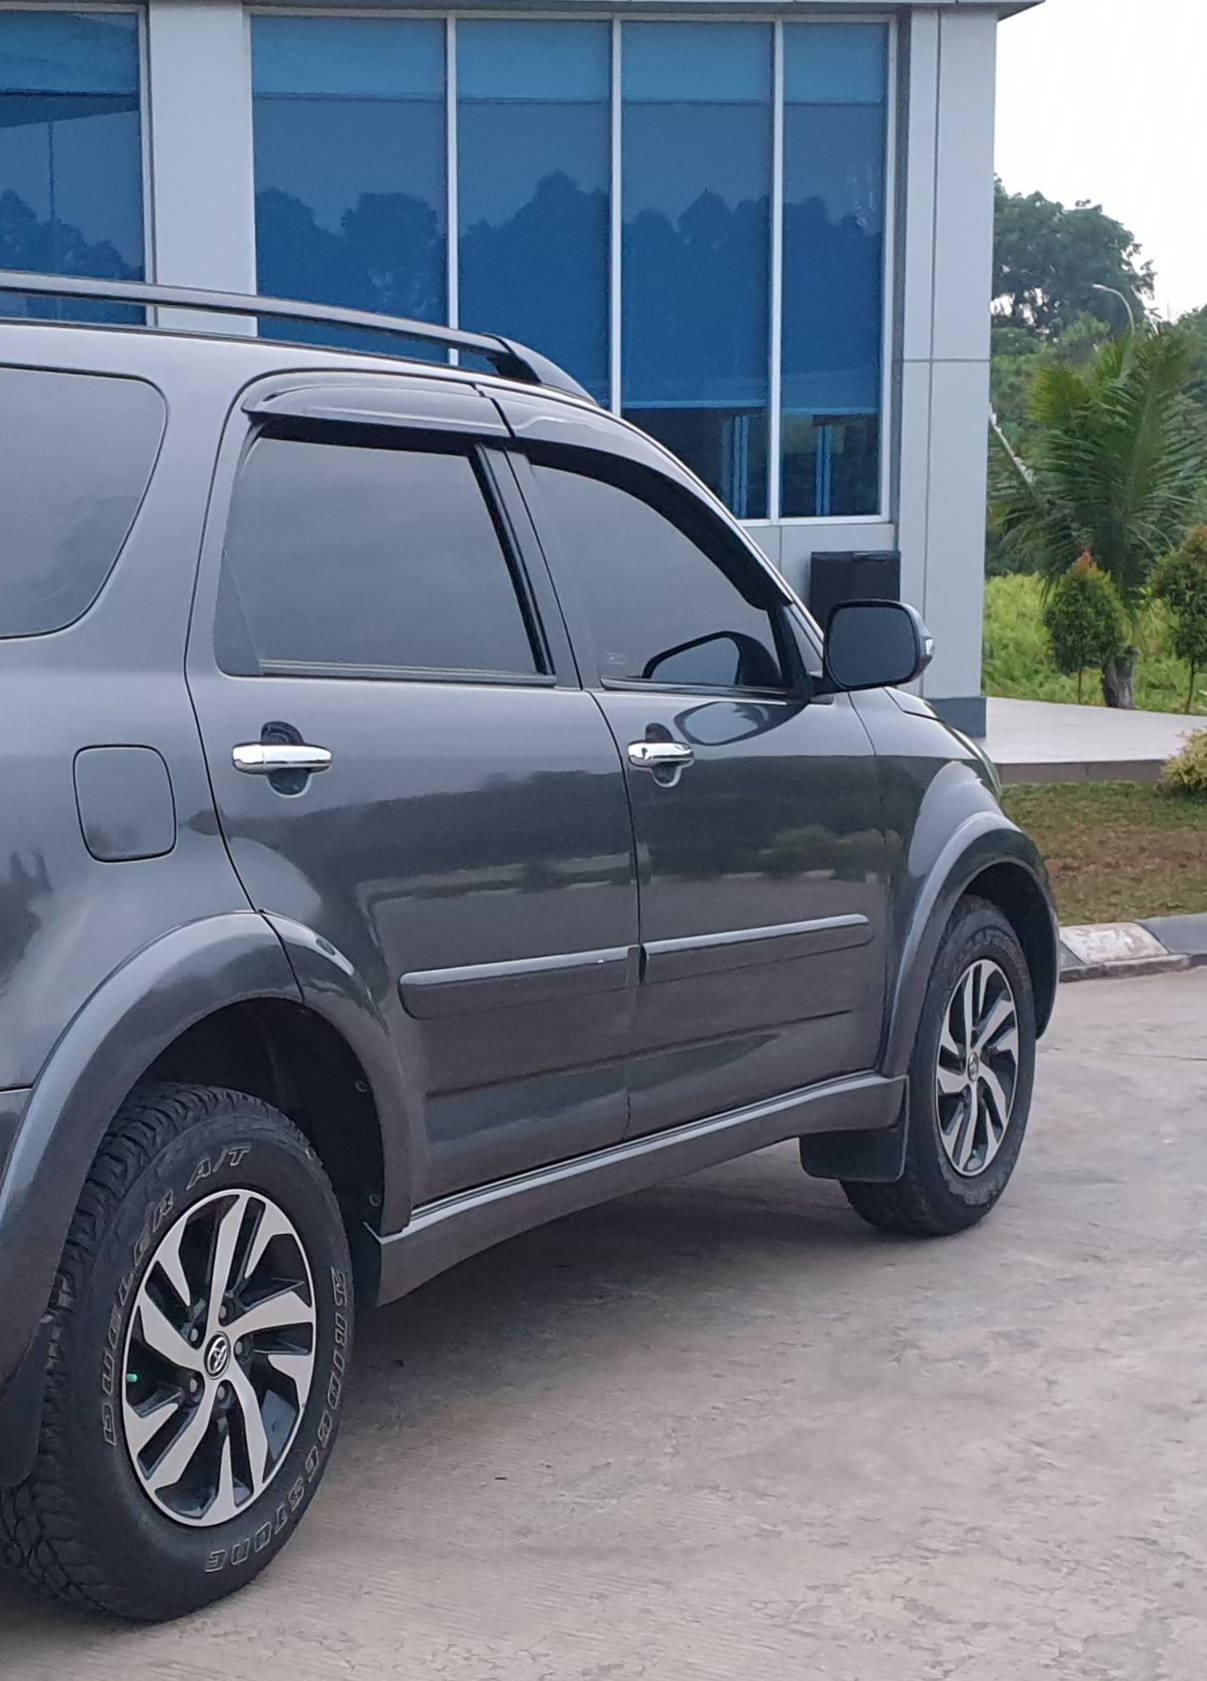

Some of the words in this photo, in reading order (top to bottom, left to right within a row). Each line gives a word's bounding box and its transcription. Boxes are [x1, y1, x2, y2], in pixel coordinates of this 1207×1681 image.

[102, 1189, 174, 1446] DUELER
[186, 1145, 251, 1190] A/T
[203, 1265, 349, 1574] BRIDGESTONE
